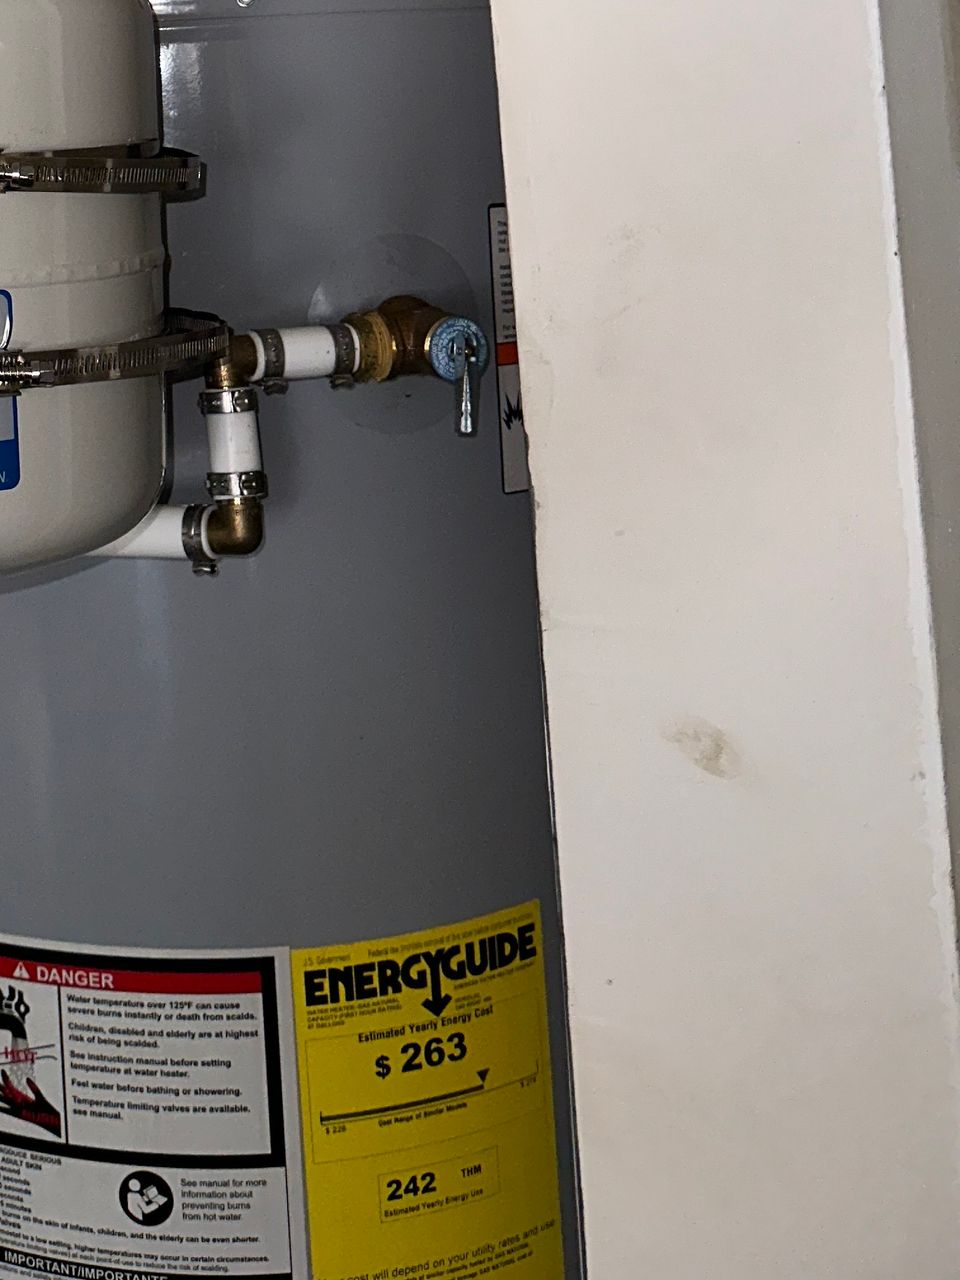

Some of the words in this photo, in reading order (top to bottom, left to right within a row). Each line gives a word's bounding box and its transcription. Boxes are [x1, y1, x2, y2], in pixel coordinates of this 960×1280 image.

[36, 966, 114, 988] DANGER
[67, 994, 91, 1004] Water
[93, 997, 144, 1008] temperature
[68, 1007, 95, 1016] severe
[98, 1008, 122, 1018] burns
[125, 1010, 161, 1022] instantly
[176, 1012, 200, 1021] death
[203, 1013, 224, 1021] from
[358, 1026, 405, 1043] Estimated
[409, 1020, 437, 1034] Yearly
[441, 1013, 472, 1027] Energy
[475, 1004, 493, 1018] Cost
[68, 1022, 106, 1034] Children,
[108, 1025, 145, 1036] disabled
[147, 1029, 164, 1037] and
[166, 1030, 195, 1040] elderly
[215, 1030, 223, 1038] at
[225, 1030, 258, 1040] highest
[69, 1033, 84, 1042] risk
[86, 1035, 95, 1043] of
[97, 1036, 121, 1047] being
[124, 1039, 160, 1048] scalded.
[70, 1050, 85, 1059] See
[87, 1052, 134, 1064] instruction
[136, 1057, 167, 1066] manual
[170, 1058, 198, 1067] before
[201, 1058, 231, 1069] setting
[375, 1054, 391, 1080] $
[401, 1032, 467, 1073] 263
[70, 1061, 121, 1074] temperature
[124, 1067, 132, 1075] at
[134, 1068, 157, 1076] water
[160, 1069, 189, 1078] heater.
[71, 1078, 89, 1087] Feel
[91, 1081, 114, 1090] water
[117, 1083, 144, 1093] before
[146, 1086, 179, 1097] bathing
[194, 1087, 242, 1097] showering.
[72, 1095, 125, 1108] Temperature
[127, 1101, 159, 1113] limiting
[162, 1104, 190, 1113] valves
[192, 1105, 206, 1113] are
[209, 1104, 250, 1113] available.
[73, 1108, 87, 1117] see
[461, 1164, 482, 1178] THM
[181, 1178, 197, 1187] See
[200, 1179, 230, 1187] manual
[232, 1179, 243, 1187] for
[386, 1172, 437, 1202] 242
[181, 1190, 227, 1199] information
[230, 1190, 253, 1198] about
[384, 1204, 420, 1217] Estimated
[421, 1199, 444, 1210] Yearly
[445, 1193, 469, 1205] Energy
[471, 1188, 483, 1197] Use
[181, 1201, 225, 1211] preventing
[227, 1201, 251, 1210] burns
[182, 1212, 201, 1221] from
[203, 1212, 216, 1221] hot
[33, 1216, 43, 1224] the
[45, 1219, 59, 1227] skin
[130, 1232, 143, 1240] and
[145, 1233, 157, 1241] the
[159, 1234, 183, 1244] elderly
[201, 1235, 210, 1243] be
[74, 1243, 95, 1253] higher
[97, 1248, 142, 1259] temperatures
[144, 1253, 158, 1262] may
[191, 1255, 215, 1263] certain
[372, 1268, 389, 1280] will
[392, 1261, 430, 1278] depend
[433, 1258, 445, 1268] on
[448, 1251, 469, 1265] your
[472, 1243, 496, 1258] utility
[498, 1234, 520, 1248] rates
[522, 1226, 538, 1239] and
